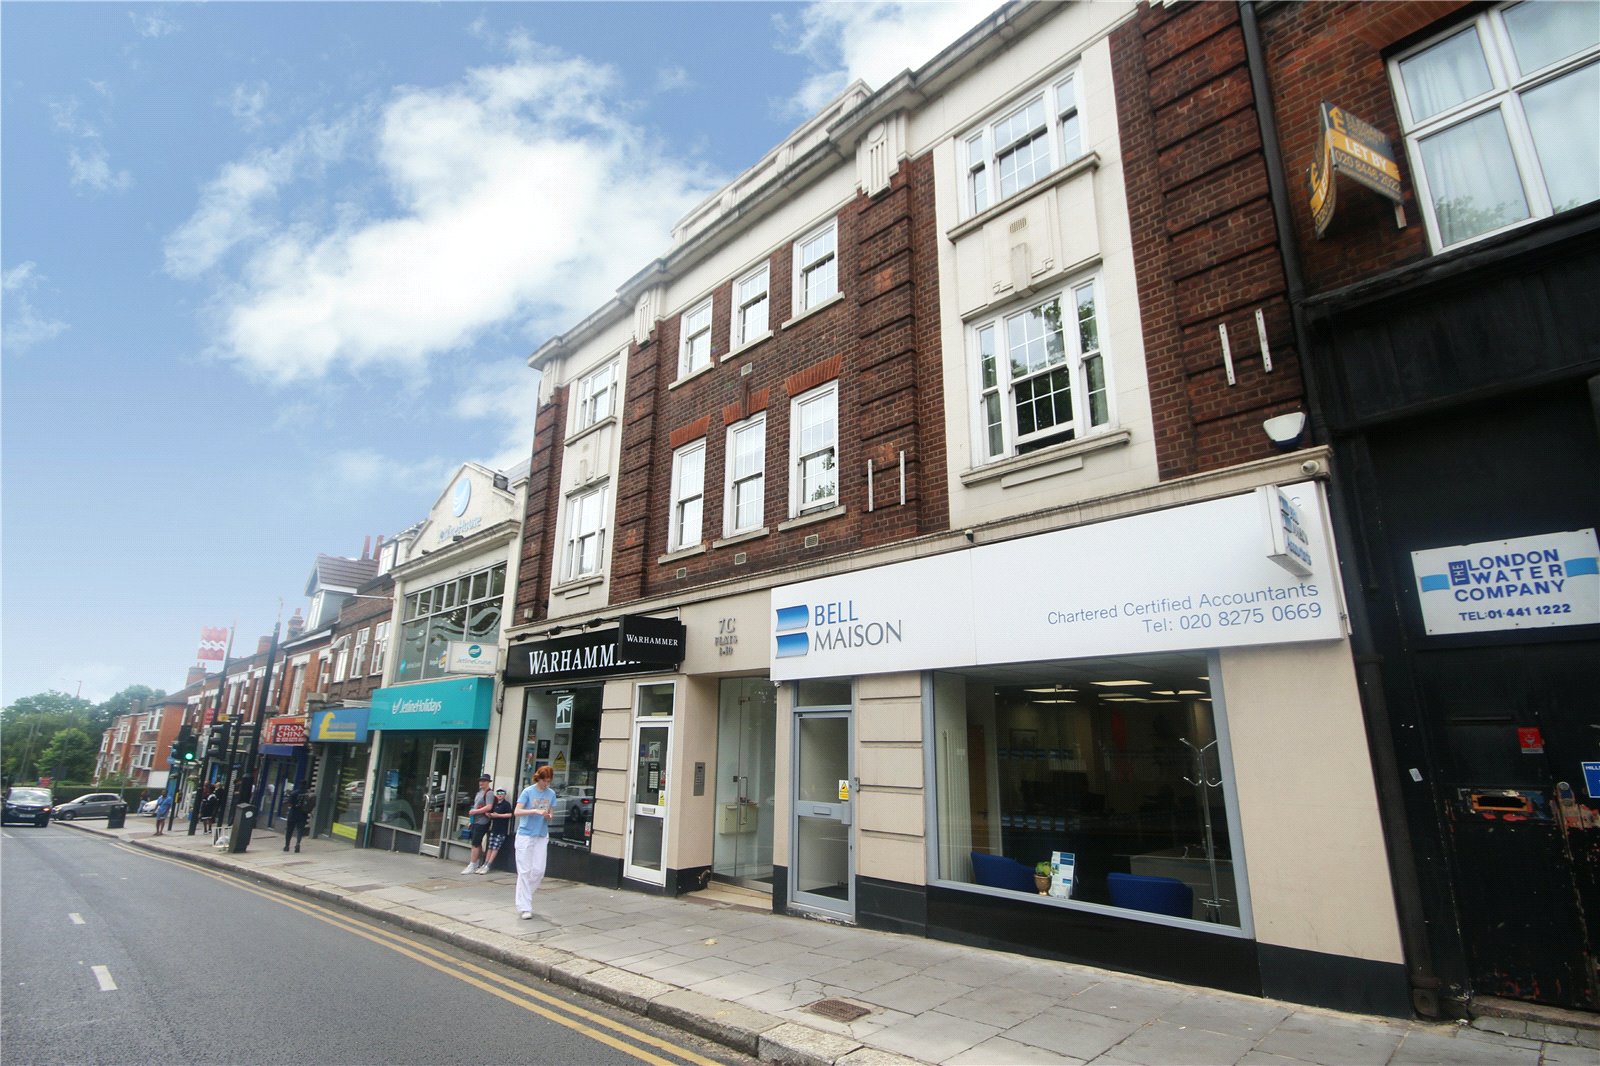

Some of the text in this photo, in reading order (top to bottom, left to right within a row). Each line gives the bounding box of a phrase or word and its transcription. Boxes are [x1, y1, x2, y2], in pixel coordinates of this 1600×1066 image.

[1345, 138, 1387, 172] LET BY
[1467, 549, 1560, 571] LONDON
[1453, 562, 1467, 583] THE
[1471, 564, 1563, 585] WATER
[1454, 579, 1565, 602] COMPANY
[814, 600, 858, 626] BELL
[1047, 582, 1319, 625] Chartered Certified Accountants
[1535, 603, 1571, 615] 1222
[1141, 602, 1322, 633] Tel: 020 8275 0669
[626, 634, 679, 646] WARHAMMER
[814, 619, 902, 651] MAISON
[529, 643, 641, 675] WARHAMM
